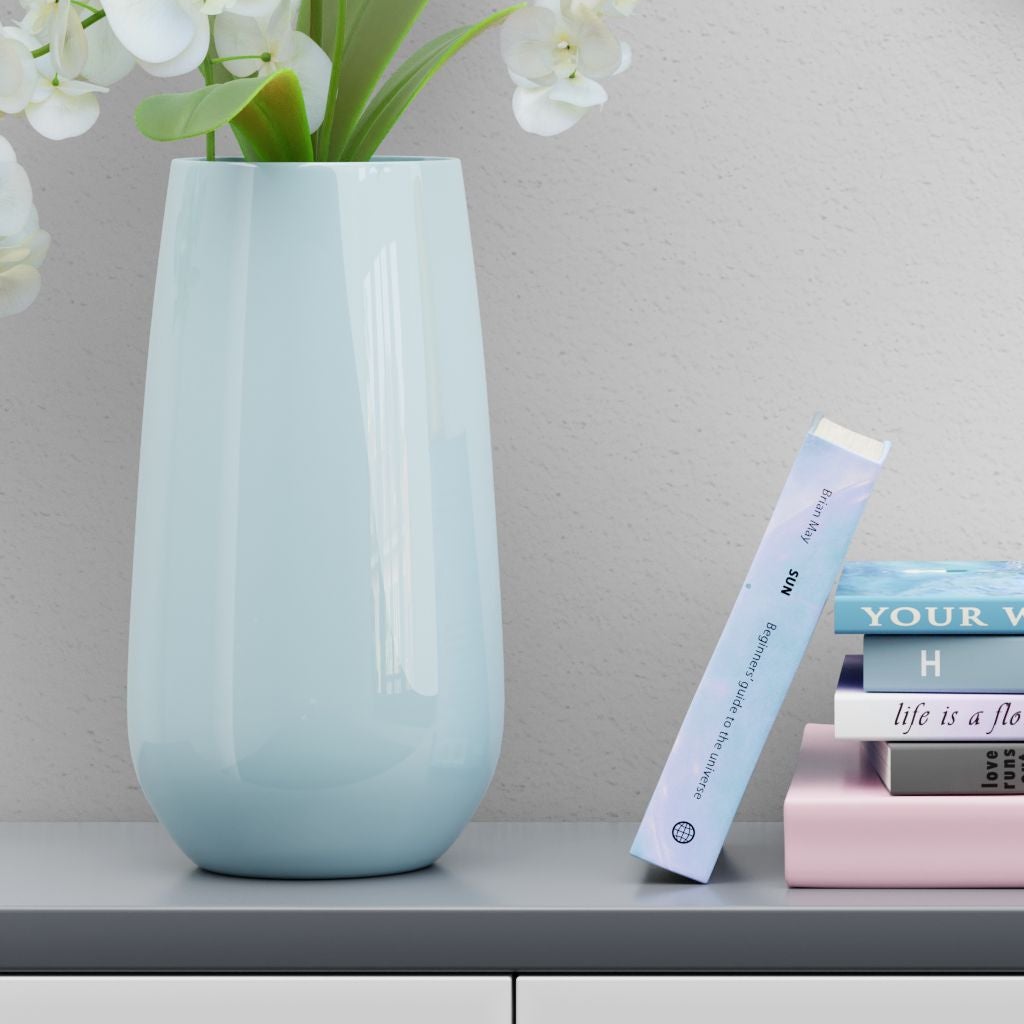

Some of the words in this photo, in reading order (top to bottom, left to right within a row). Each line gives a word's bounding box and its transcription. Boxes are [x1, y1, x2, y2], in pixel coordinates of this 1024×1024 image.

[813, 488, 833, 518] Brian
[800, 519, 820, 545] May
[780, 568, 799, 597] SUN
[860, 606, 989, 627] YOUR
[729, 680, 749, 714] guide
[723, 716, 735, 728] to
[893, 702, 930, 735] life
[940, 704, 959, 726] is
[967, 710, 984, 726] a
[713, 731, 729, 750] the
[693, 752, 719, 800] universe
[981, 750, 999, 788] love
[1003, 748, 1016, 790] runs
